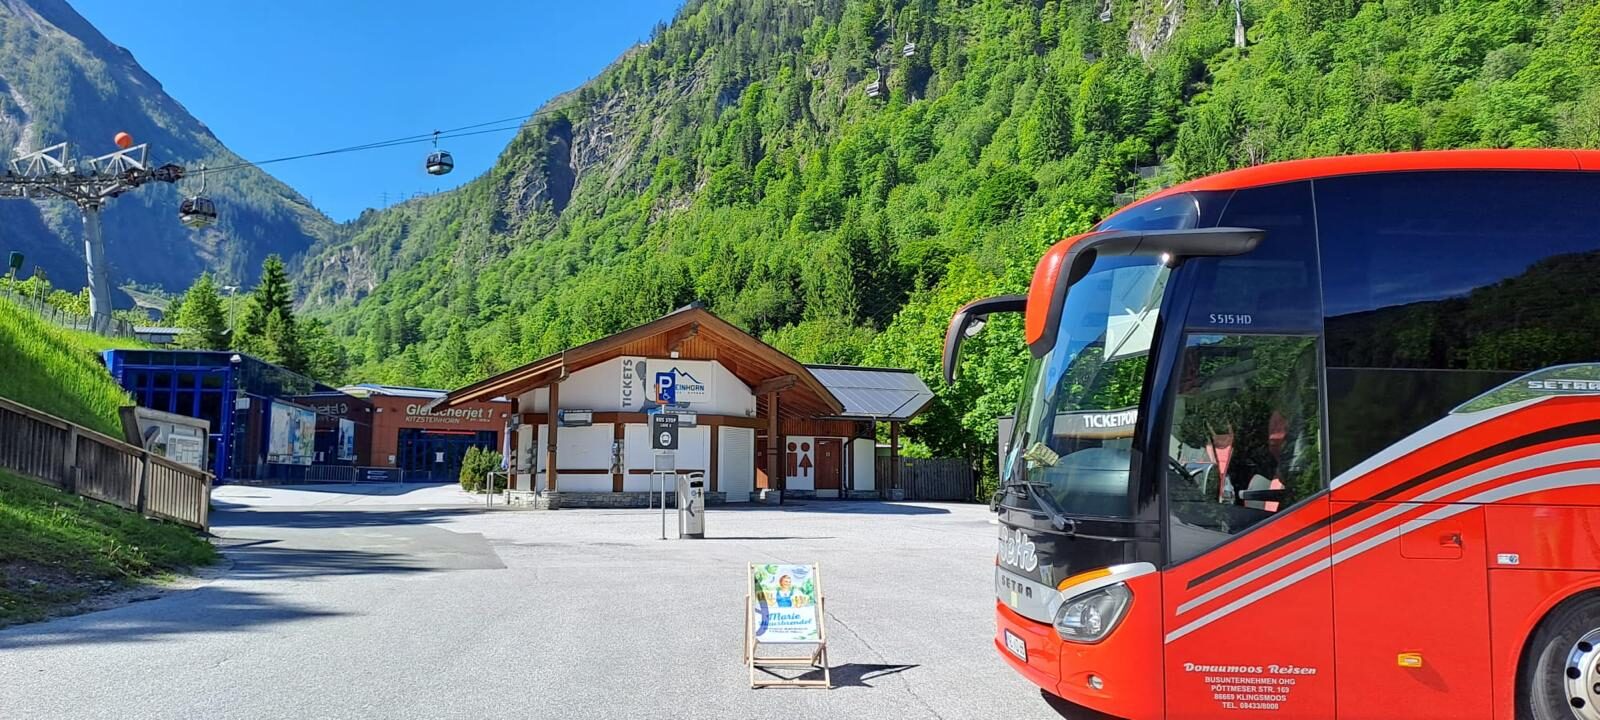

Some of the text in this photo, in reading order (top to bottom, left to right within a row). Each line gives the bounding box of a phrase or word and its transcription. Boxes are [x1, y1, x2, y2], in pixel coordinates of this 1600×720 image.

[1209, 314, 1252, 324] S 515 HD
[622, 359, 633, 408] TICKETS
[659, 375, 673, 394] P
[1527, 380, 1600, 390] SETRA
[487, 408, 494, 418] 1
[405, 415, 460, 424] KITZSTEINHORN
[1083, 409, 1139, 428] TICKETPOIN
[1001, 574, 1033, 599] SETRA
[768, 612, 801, 621] Marie
[1267, 664, 1317, 675] Reisen
[1204, 676, 1296, 685] BUSUNTERNEHMEN OHG
[1236, 694, 1287, 702] KLINGSMOOS
[1222, 701, 1238, 709] TEL.
